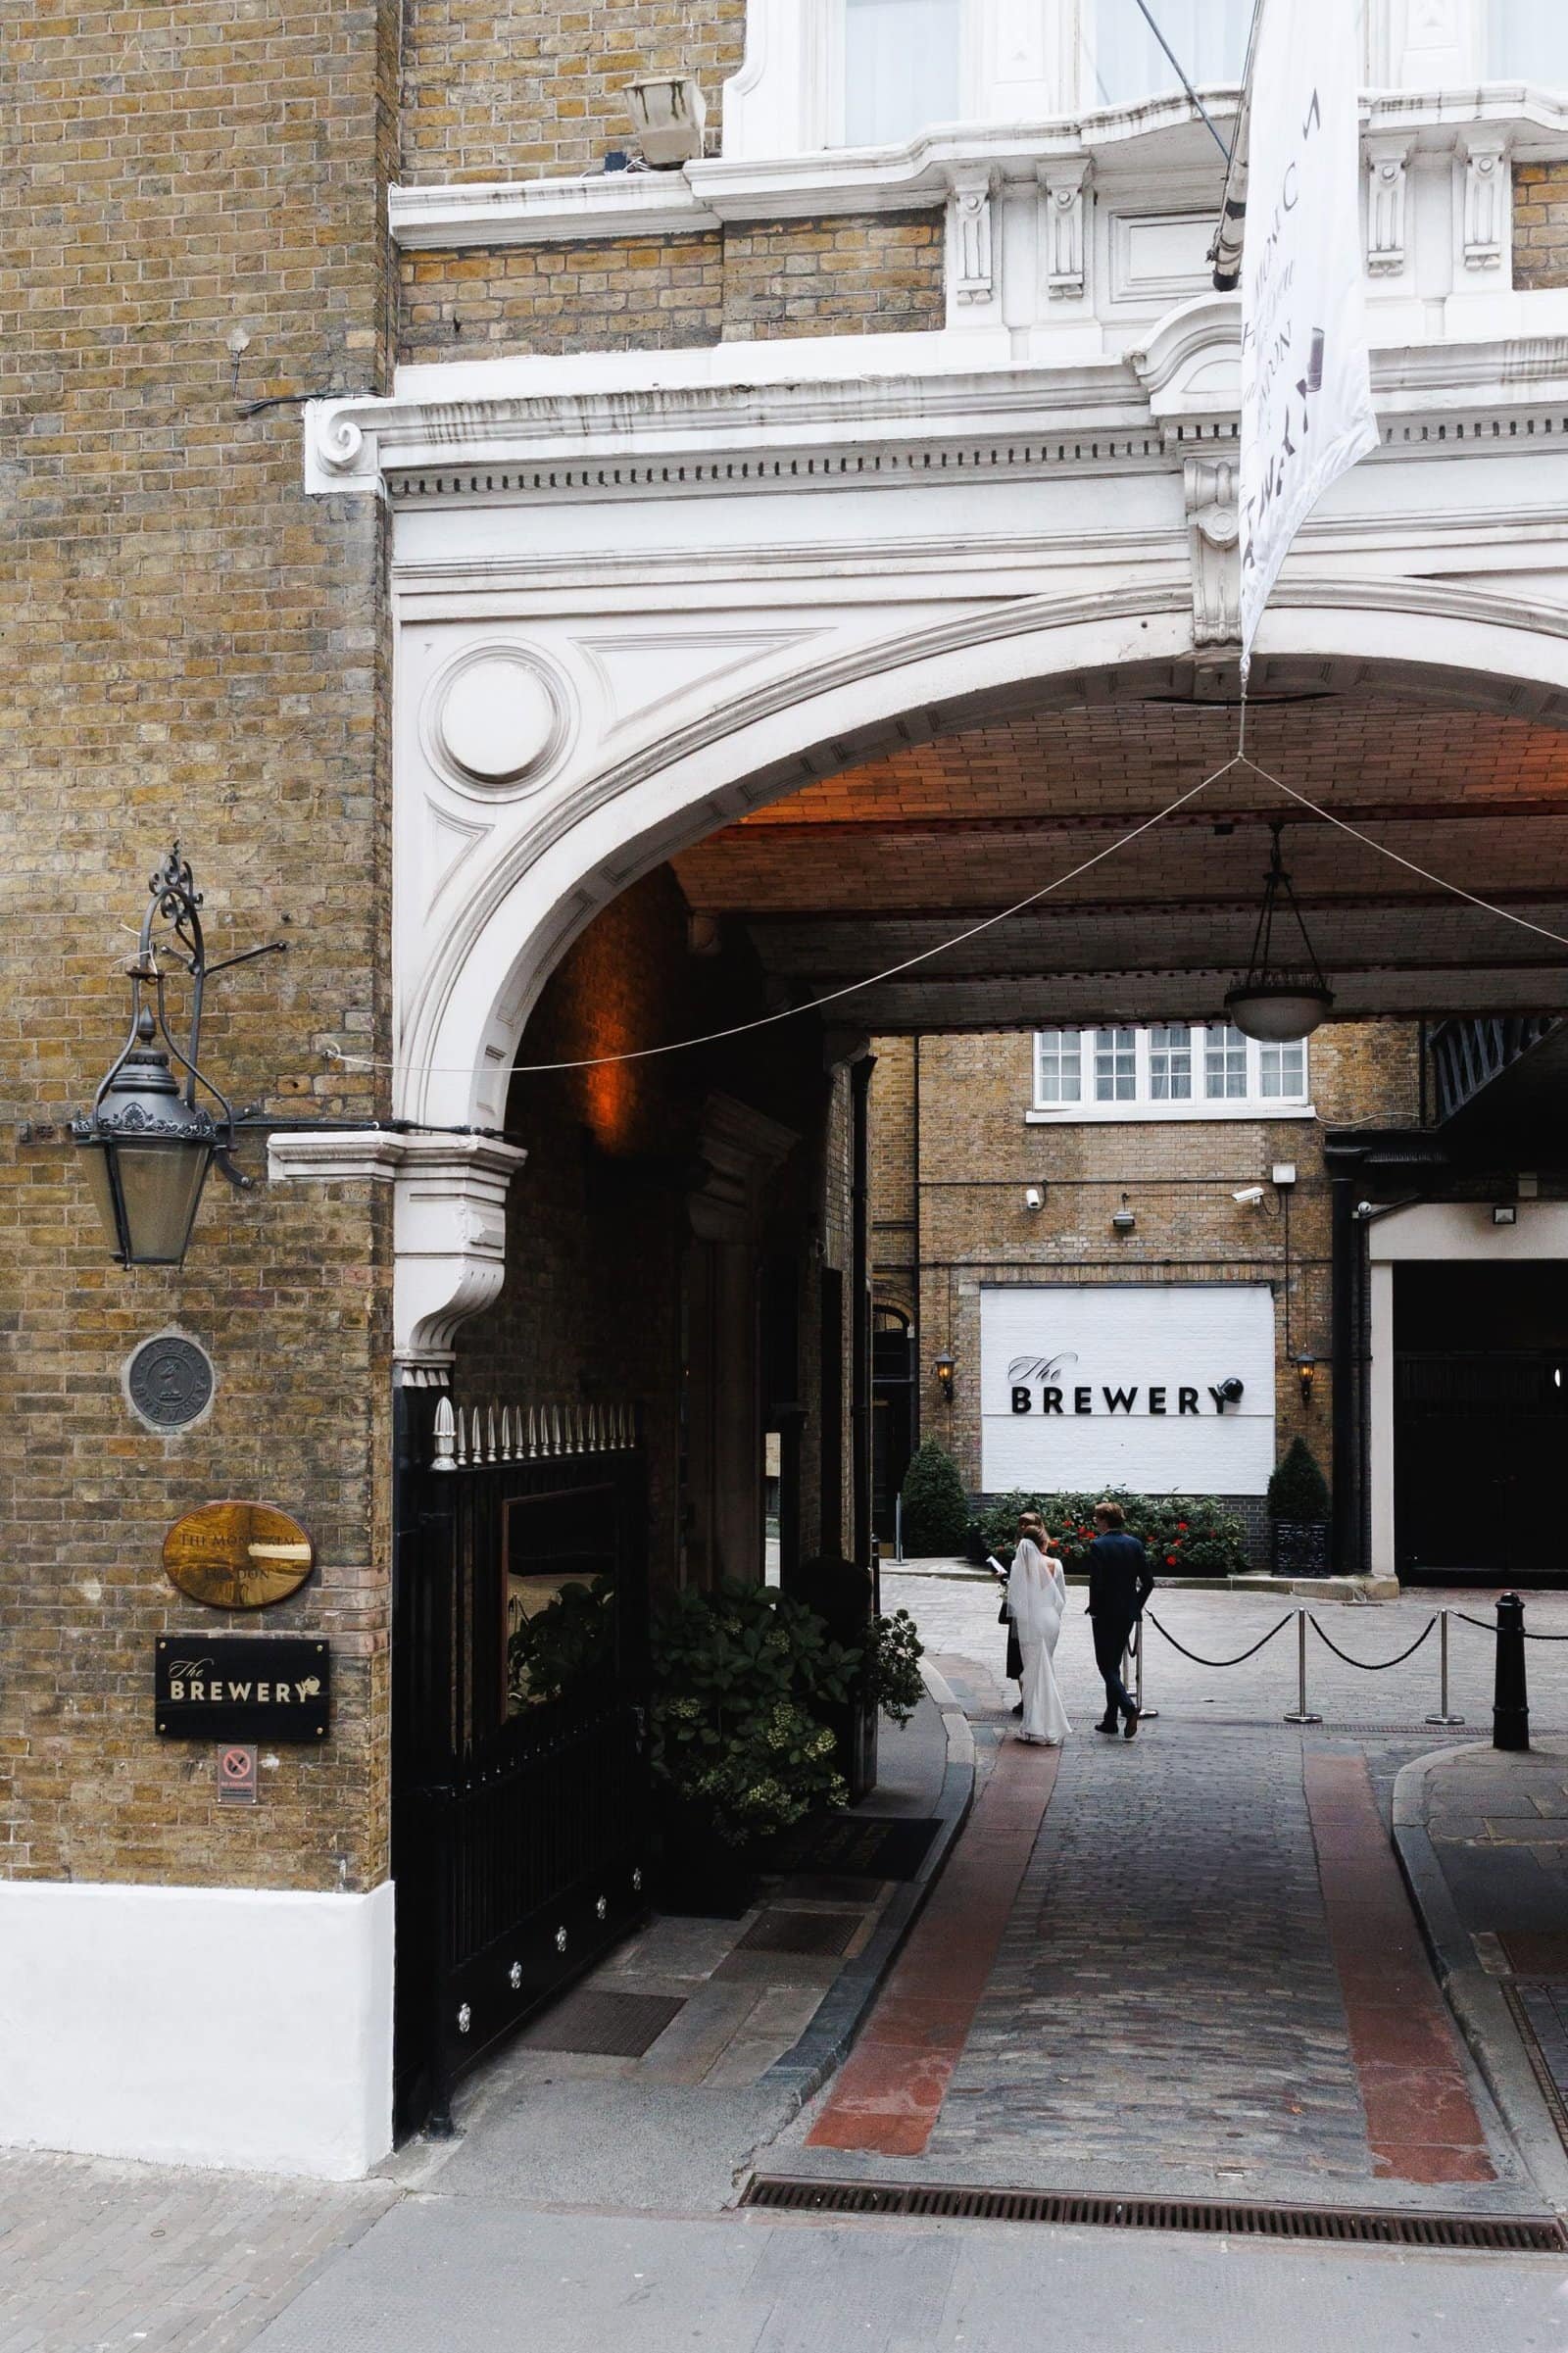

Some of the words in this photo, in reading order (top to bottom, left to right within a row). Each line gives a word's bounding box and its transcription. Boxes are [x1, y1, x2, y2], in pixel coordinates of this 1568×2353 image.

[1007, 1352, 1078, 1382] The
[1011, 1386, 1229, 1414] BREWERY
[169, 1658, 215, 1678] The
[171, 1681, 311, 1702] BREWERY
